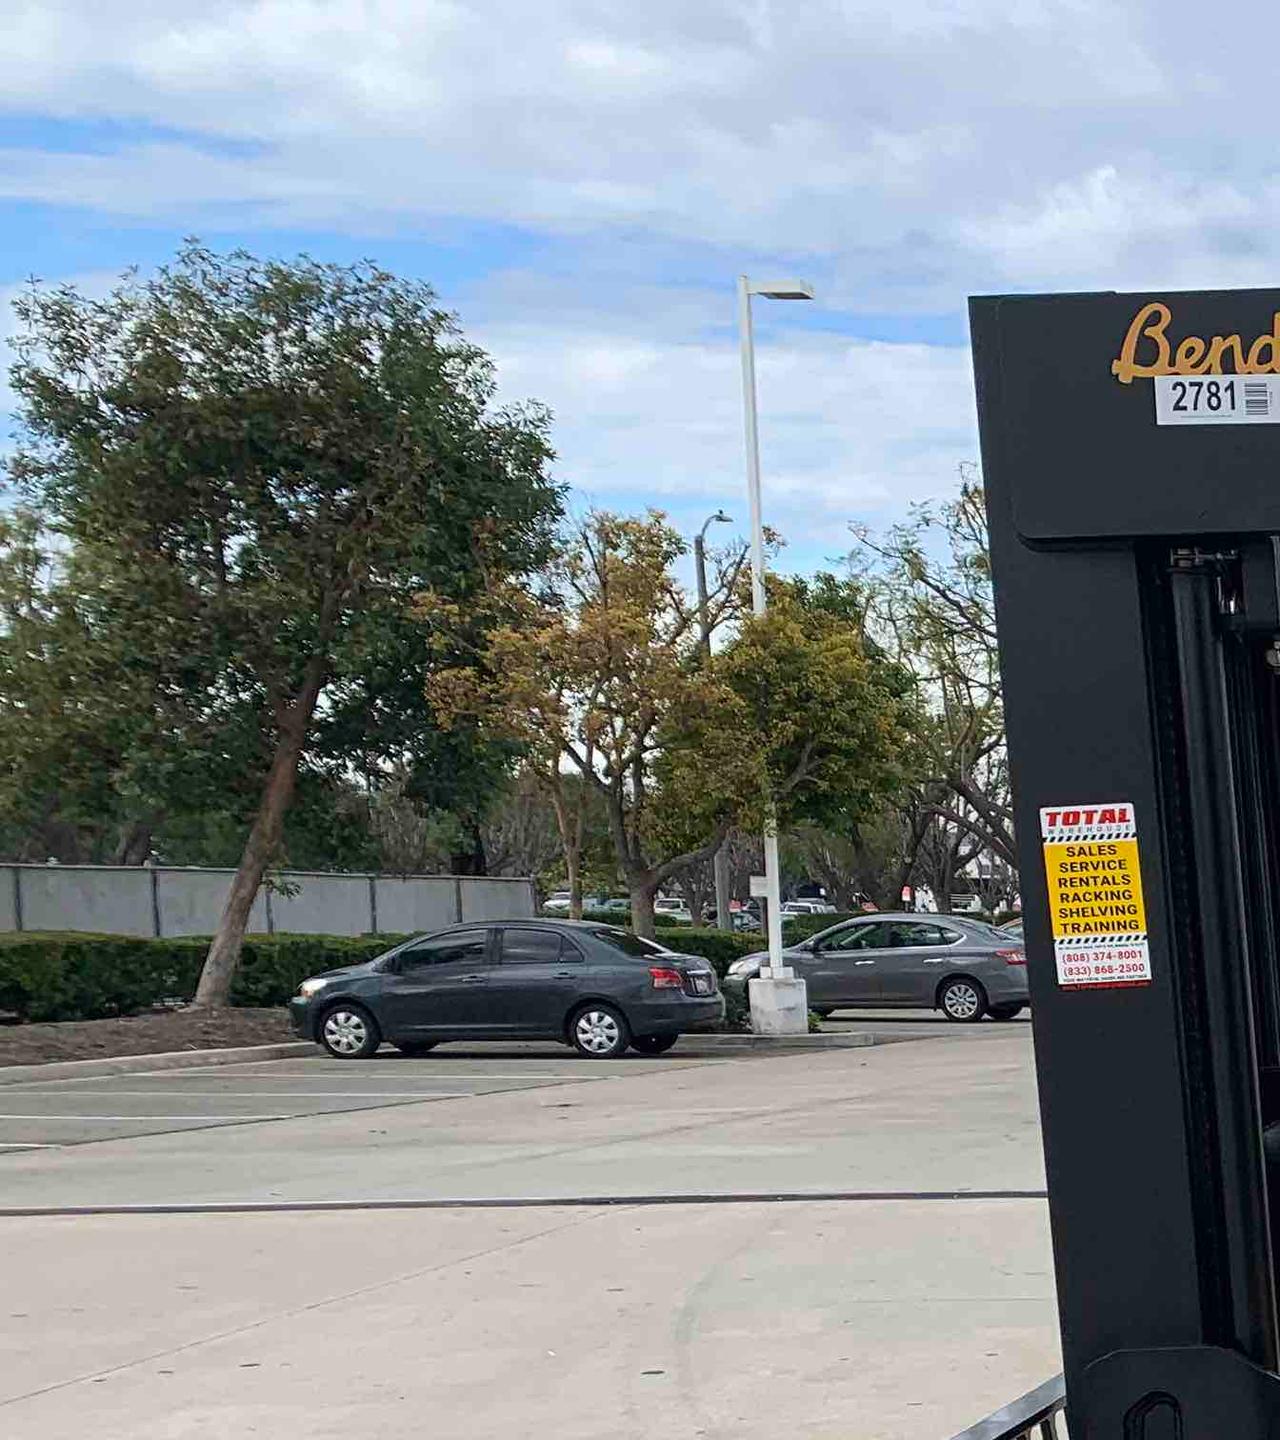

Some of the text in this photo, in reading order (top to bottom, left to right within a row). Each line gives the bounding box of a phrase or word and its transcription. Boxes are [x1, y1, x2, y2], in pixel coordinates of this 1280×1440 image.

[1172, 380, 1236, 411] 2781
[1046, 808, 1131, 827] TOTAL
[1066, 844, 1117, 858] SALES
[1059, 858, 1127, 873] SERVICE
[1058, 874, 1131, 888] RENTALS
[1060, 889, 1133, 904] RACKING
[1059, 904, 1138, 919] SHELVING
[1060, 919, 1139, 935] TRAINING
